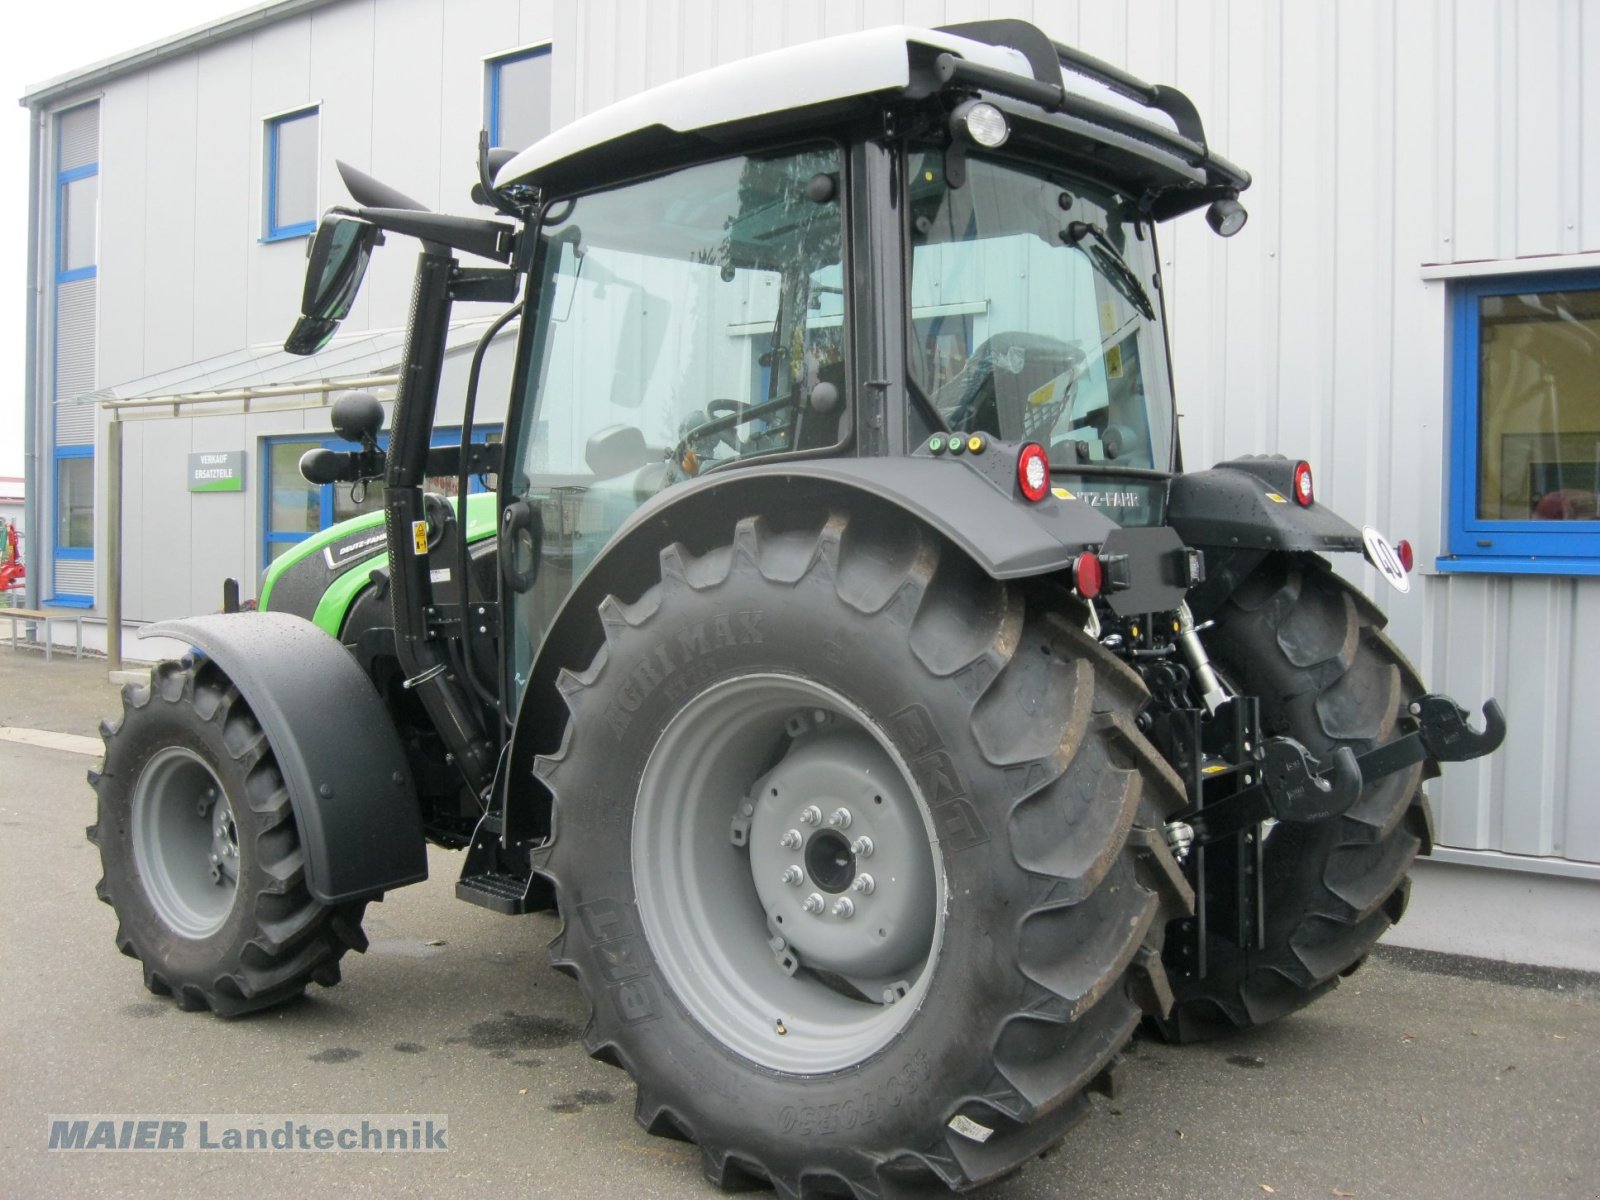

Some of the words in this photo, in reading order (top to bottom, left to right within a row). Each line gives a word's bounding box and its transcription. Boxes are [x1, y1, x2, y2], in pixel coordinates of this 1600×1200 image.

[200, 454, 228, 464] VERKAUF
[195, 468, 233, 479] ERSATZTEILE
[889, 703, 990, 851] BKT
